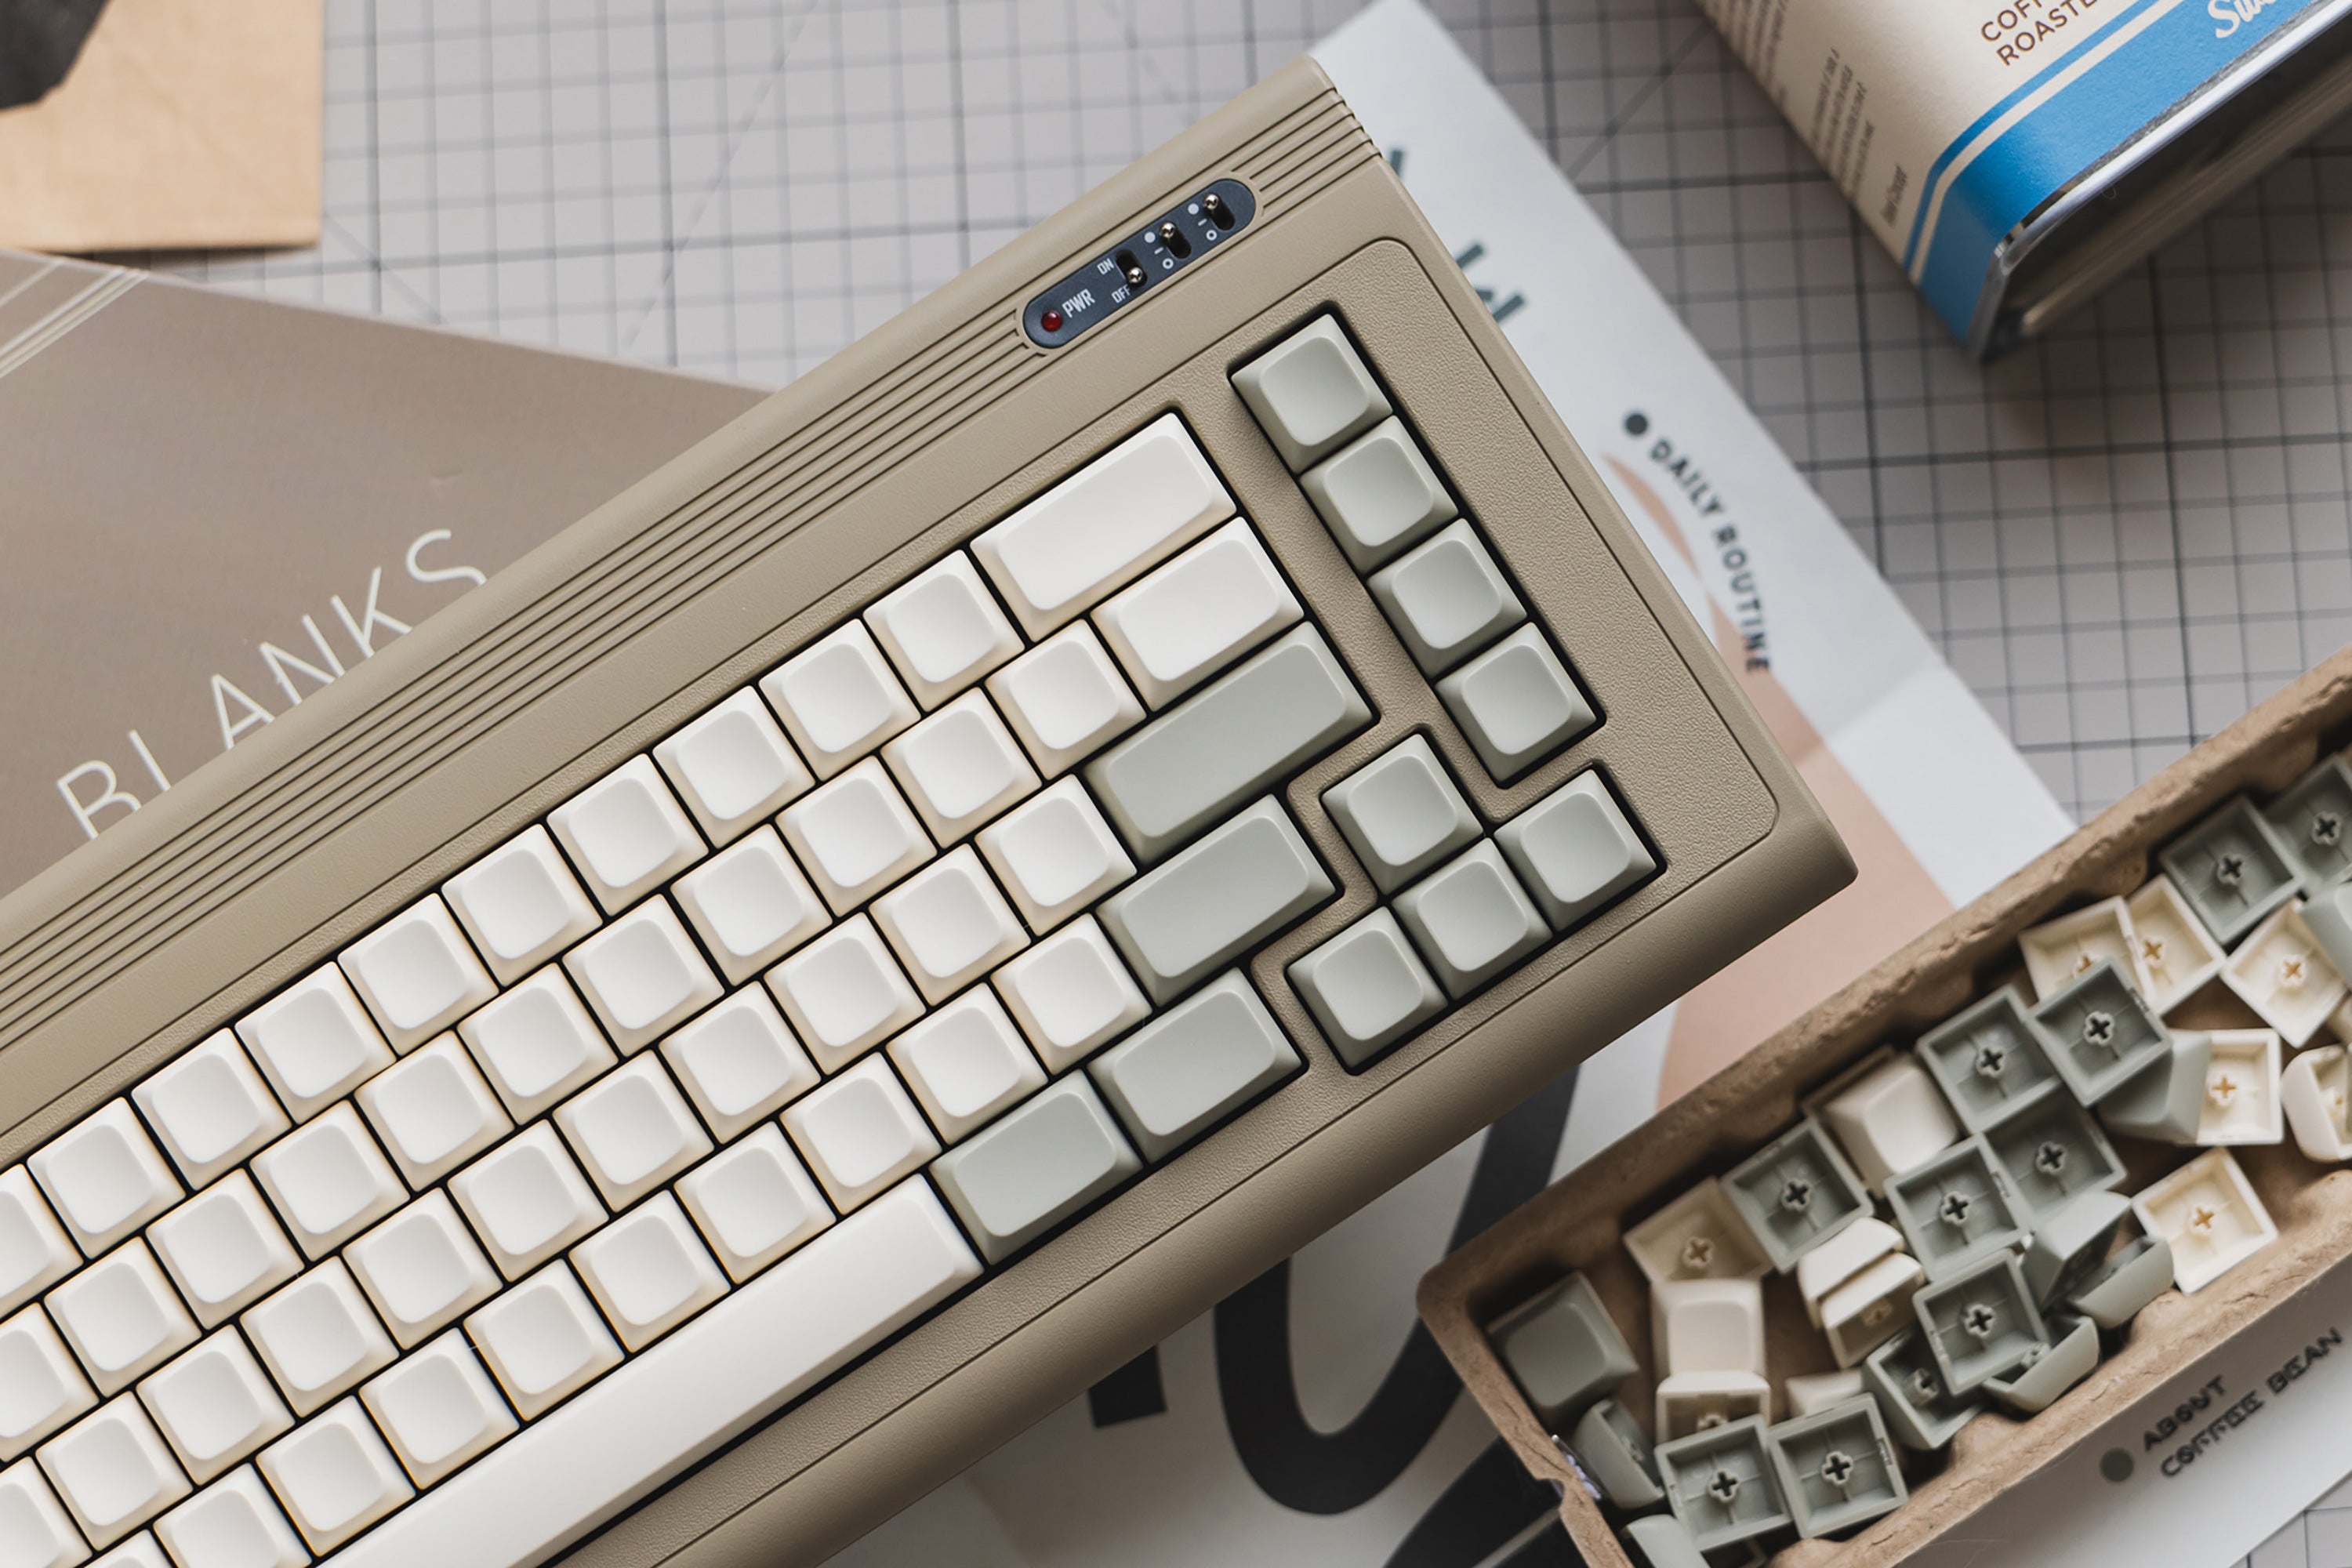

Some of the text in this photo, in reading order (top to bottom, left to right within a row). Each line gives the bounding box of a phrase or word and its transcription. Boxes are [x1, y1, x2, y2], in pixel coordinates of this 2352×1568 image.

[1981, 0, 2042, 42] COF
[1097, 258, 1114, 275] ON
[1062, 289, 1096, 318] PWR
[1111, 284, 1131, 304] OFF
[1650, 439, 1769, 673] DAILY ROUTINE
[2143, 1374, 2227, 1451] ABOUT
[2160, 1327, 2344, 1477] COFFEE BEAN
